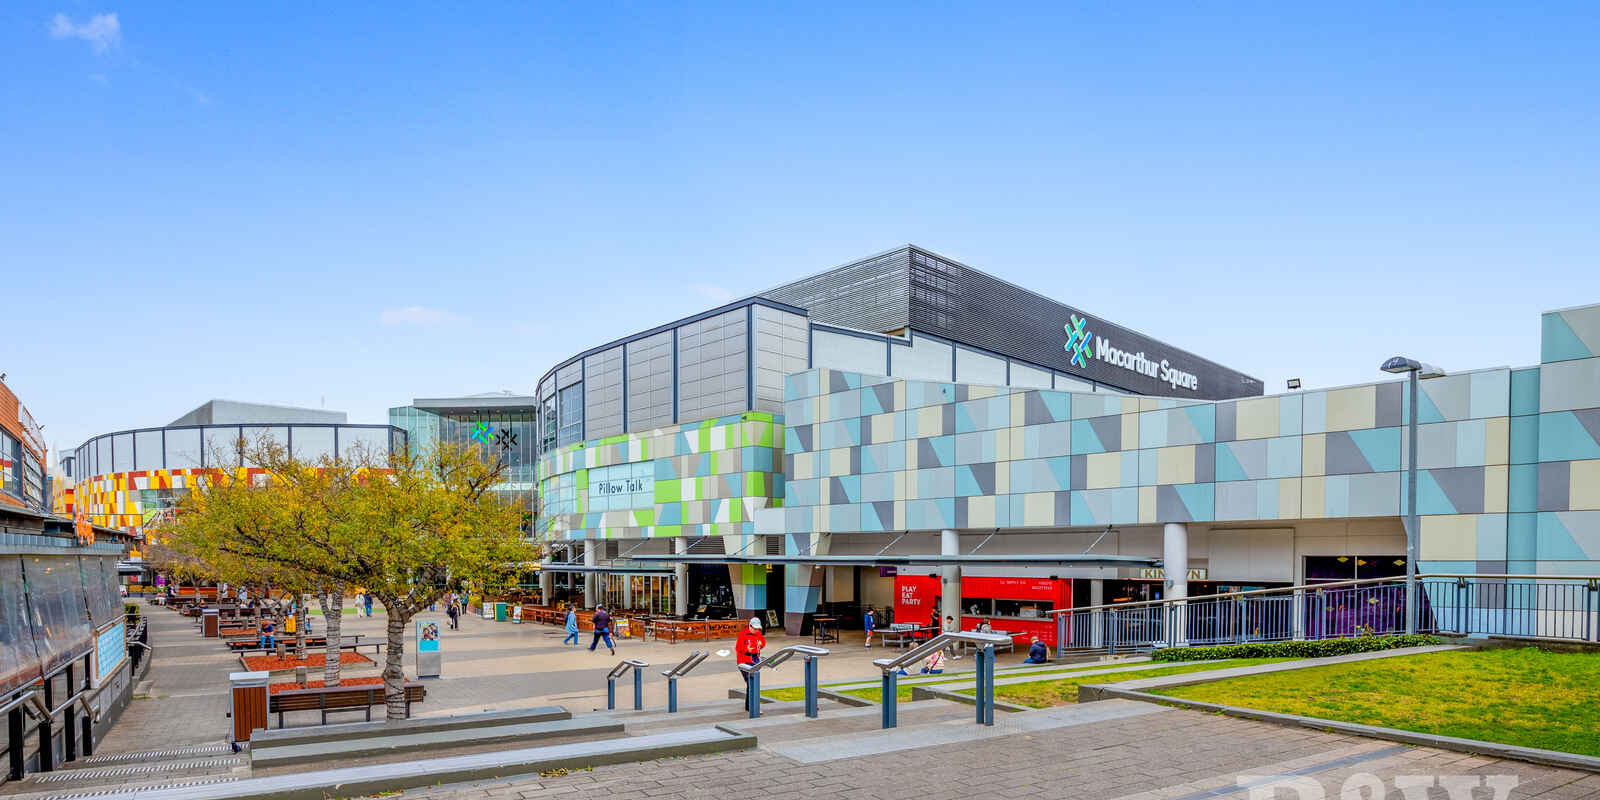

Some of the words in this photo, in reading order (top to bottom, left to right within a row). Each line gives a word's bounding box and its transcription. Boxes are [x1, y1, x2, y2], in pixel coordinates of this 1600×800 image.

[1095, 336, 1160, 378] Macarthur
[1160, 359, 1198, 390] Square
[598, 483, 622, 494] Pillow
[625, 480, 642, 491] Talk
